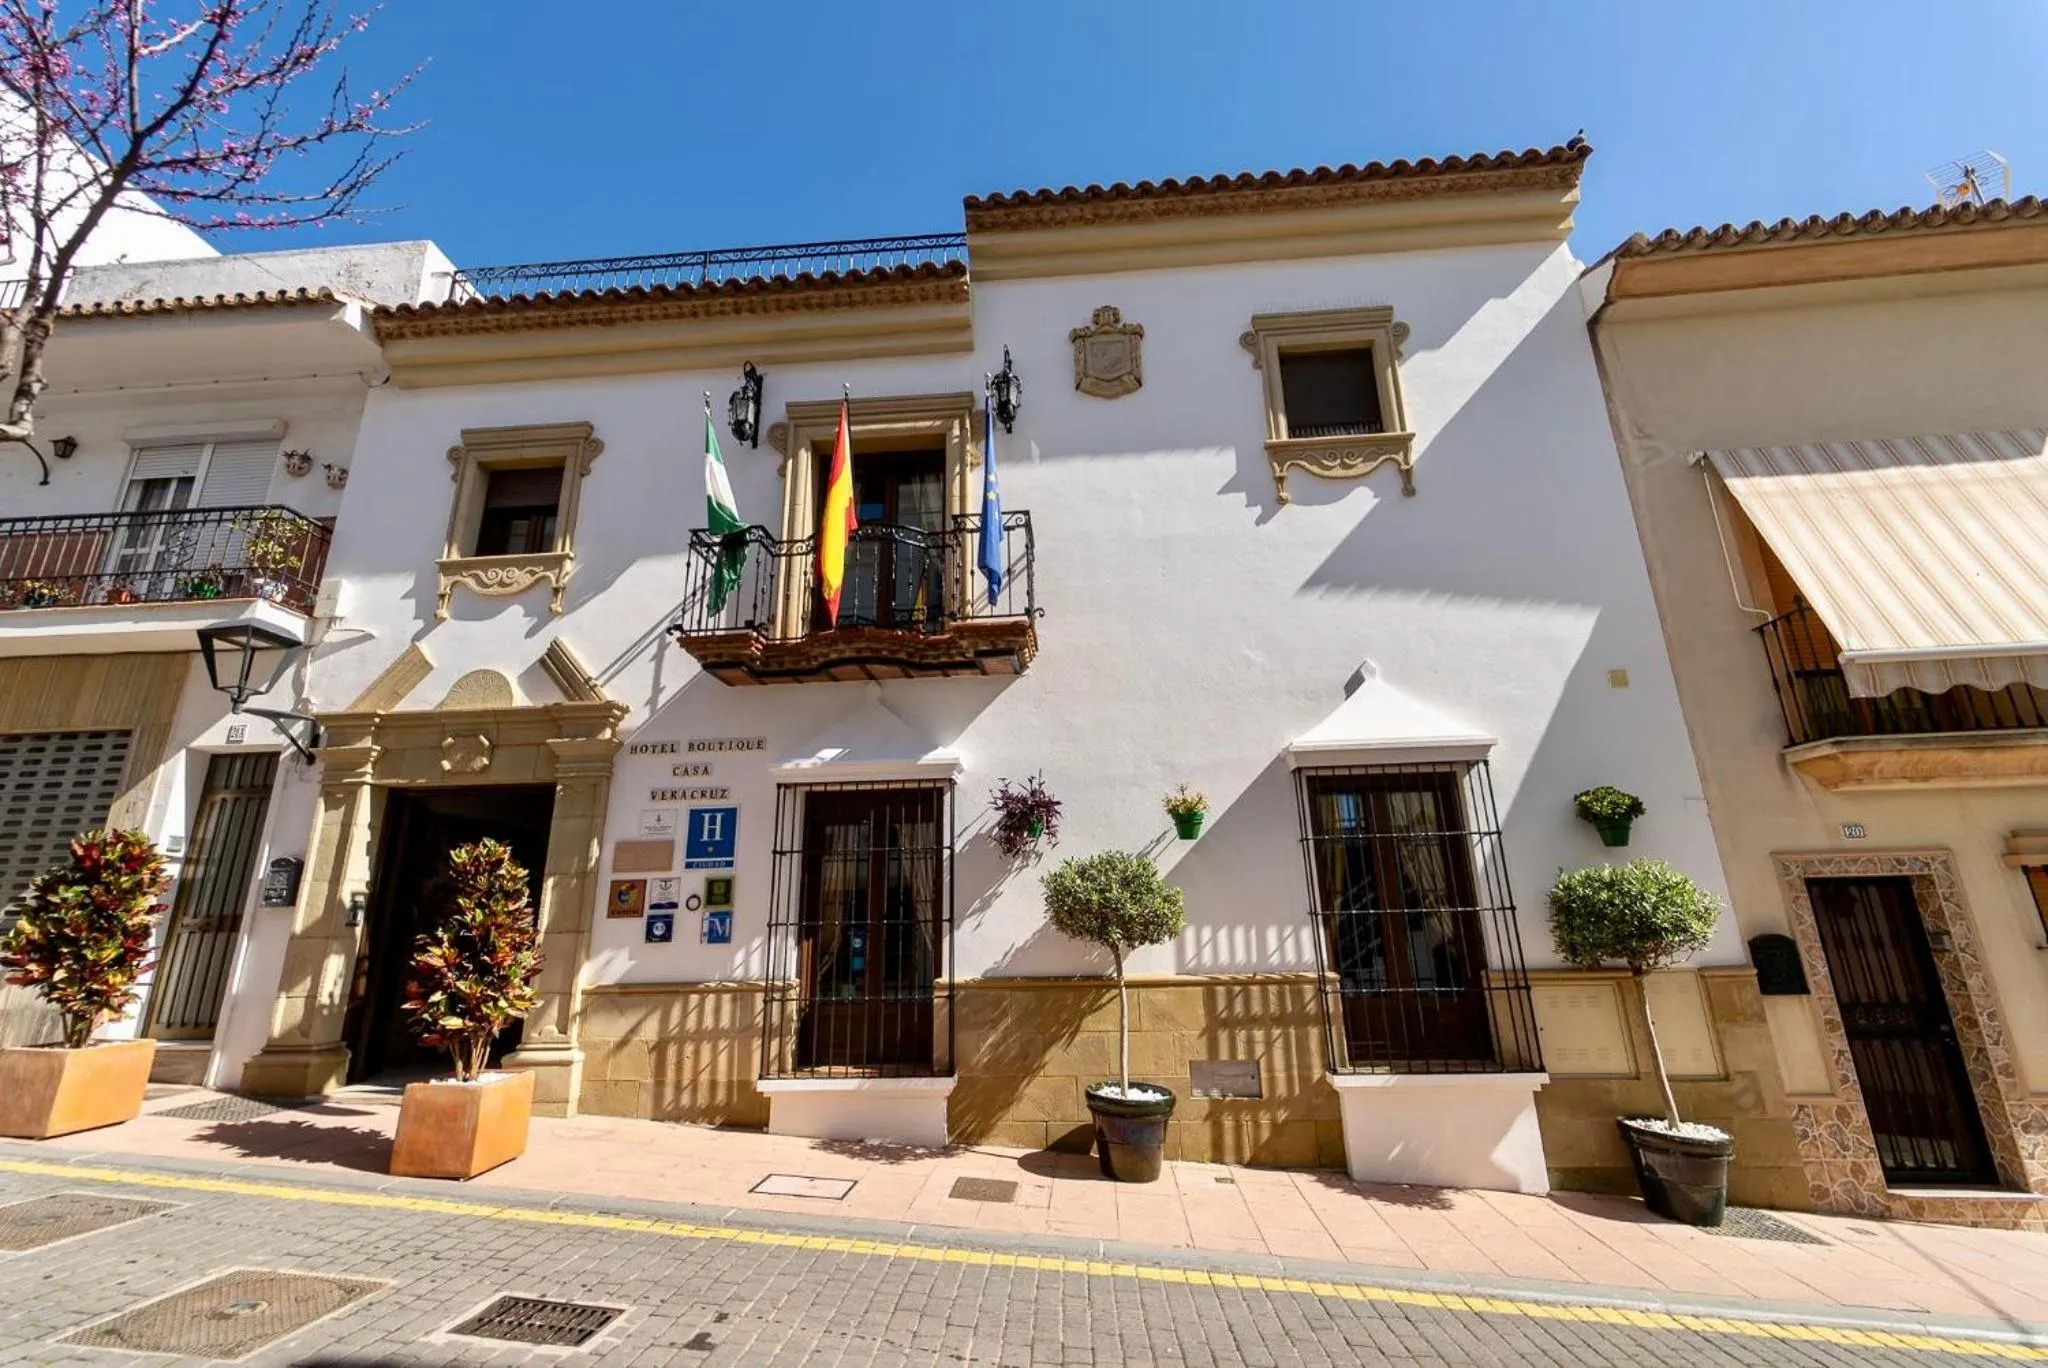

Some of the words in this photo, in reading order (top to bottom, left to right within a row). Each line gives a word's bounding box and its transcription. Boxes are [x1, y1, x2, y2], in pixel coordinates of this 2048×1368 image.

[630, 743, 678, 755] HOTEL
[687, 739, 764, 753] BOUTIQUE
[672, 764, 710, 777] CASA
[650, 787, 729, 801] VERACRUZ
[700, 812, 726, 842] H
[709, 918, 731, 938] M
